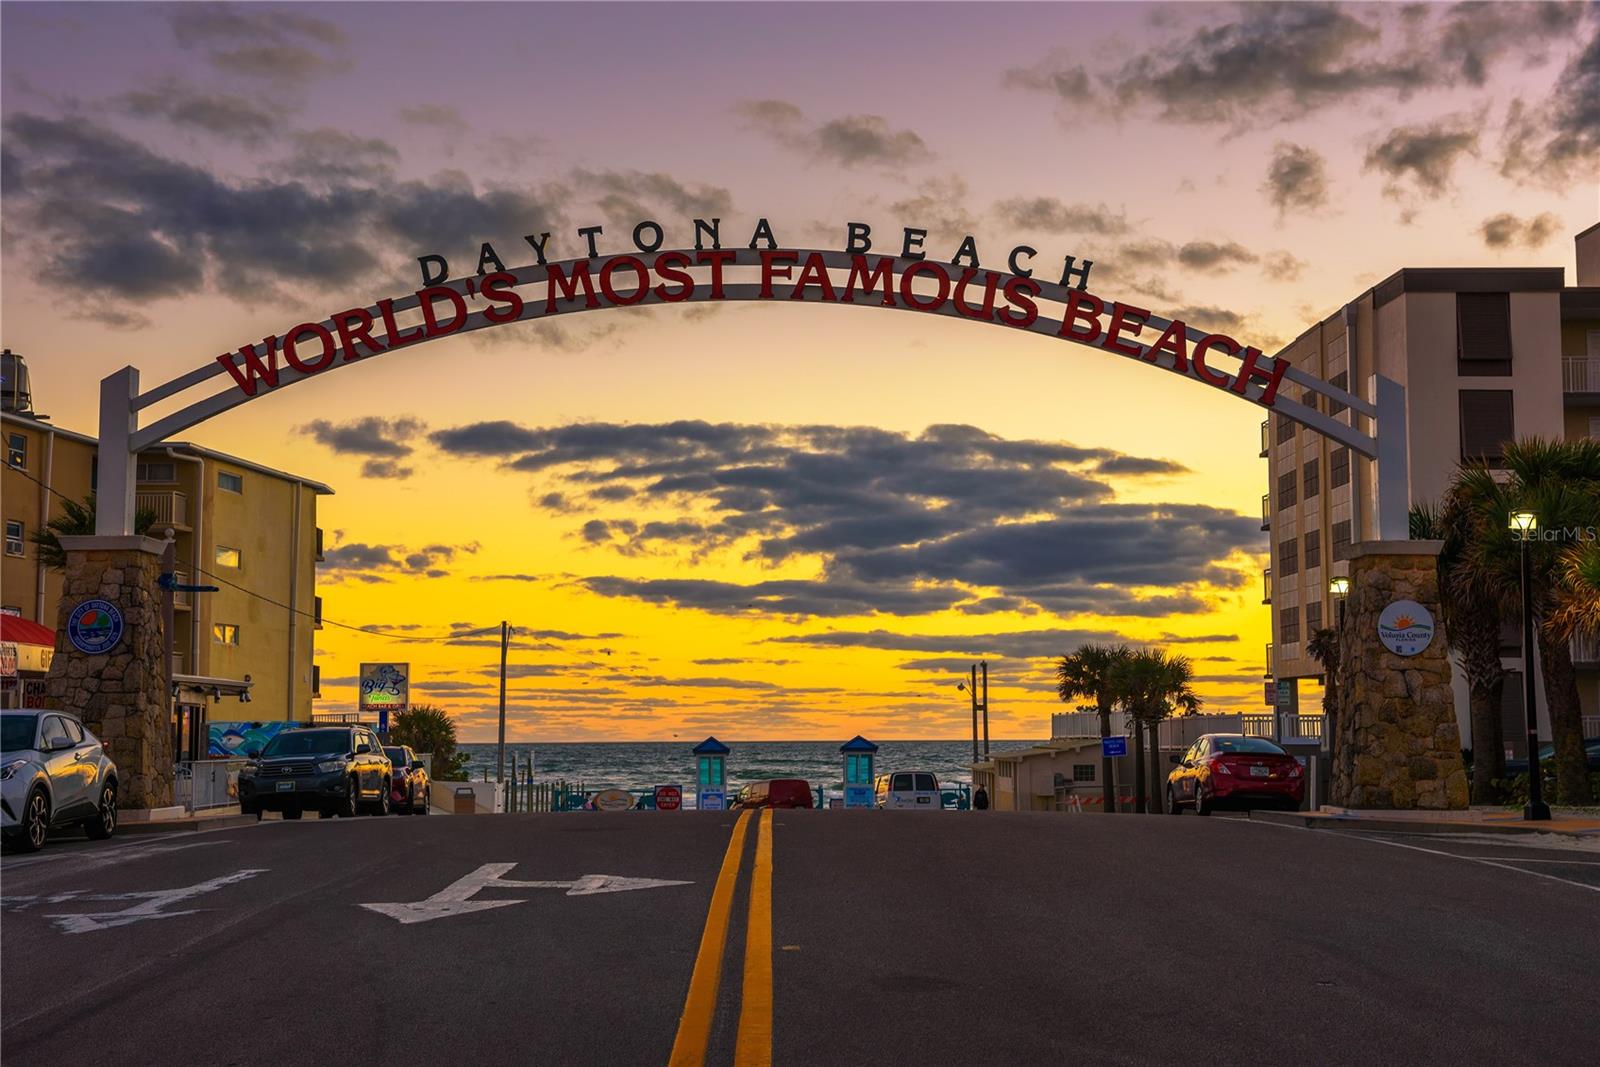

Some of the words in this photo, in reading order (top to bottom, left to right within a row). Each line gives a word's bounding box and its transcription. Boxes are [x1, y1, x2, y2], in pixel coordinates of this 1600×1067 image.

[418, 218, 777, 286] DAYTONA
[846, 222, 1094, 291] BEACH
[216, 273, 524, 396] WORLD'S
[546, 251, 736, 313] MOST
[760, 251, 1041, 328] FAMOUS
[1058, 290, 1291, 406] BEACH
[1381, 631, 1405, 640] Volusia
[1406, 631, 1430, 640] County
